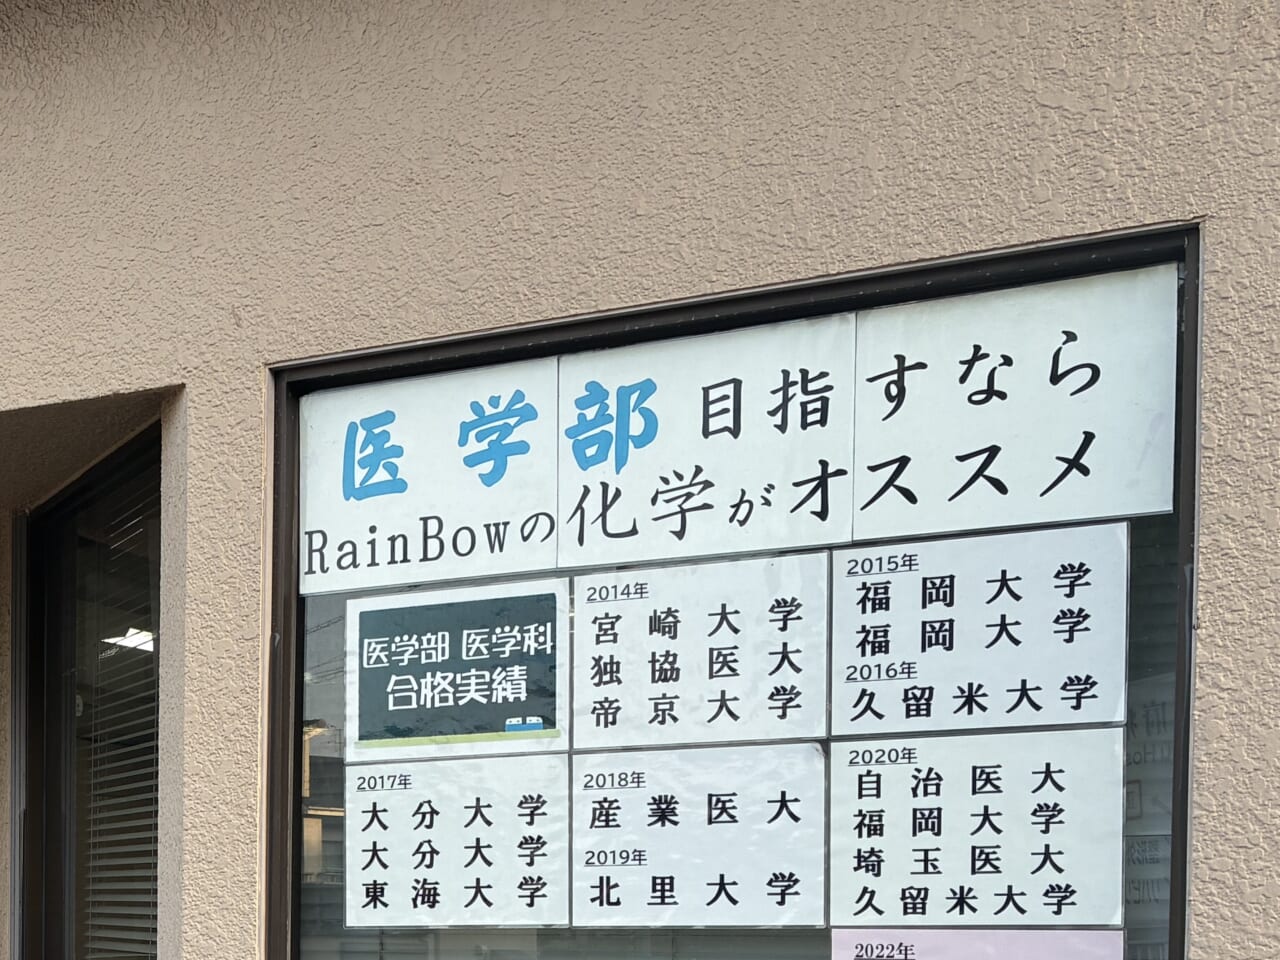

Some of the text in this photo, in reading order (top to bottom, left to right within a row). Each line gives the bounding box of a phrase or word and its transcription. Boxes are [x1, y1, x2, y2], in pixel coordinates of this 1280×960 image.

[847, 553, 919, 575] 2015年
[586, 582, 649, 602] 2014年
[856, 561, 1092, 615] 福岡大学
[591, 597, 803, 645] 宮崎大学
[856, 607, 1091, 657] 福岡大学
[363, 622, 553, 668] 医学部 医学科
[590, 641, 803, 687] 独協医大
[846, 661, 918, 681] 2016年
[386, 665, 528, 711] 合格実績
[590, 684, 802, 729] 帝京大学
[850, 674, 1098, 722] 久留米大学
[848, 747, 917, 765] 2020年
[357, 774, 412, 790] 2017年
[583, 771, 646, 788] 2018年
[857, 762, 1066, 801] 自治医大
[361, 793, 548, 832] 大分大学
[589, 790, 801, 829] 産業医大
[853, 802, 1065, 839] 福岡大学
[361, 834, 548, 871] 大分大学
[585, 849, 648, 866] 2019年
[853, 844, 1065, 878] 埼玉医大
[361, 875, 548, 909] 東海大学
[590, 871, 801, 907] 北里大学
[853, 883, 1077, 916] 久留米大学
[855, 942, 916, 960] 2022年
